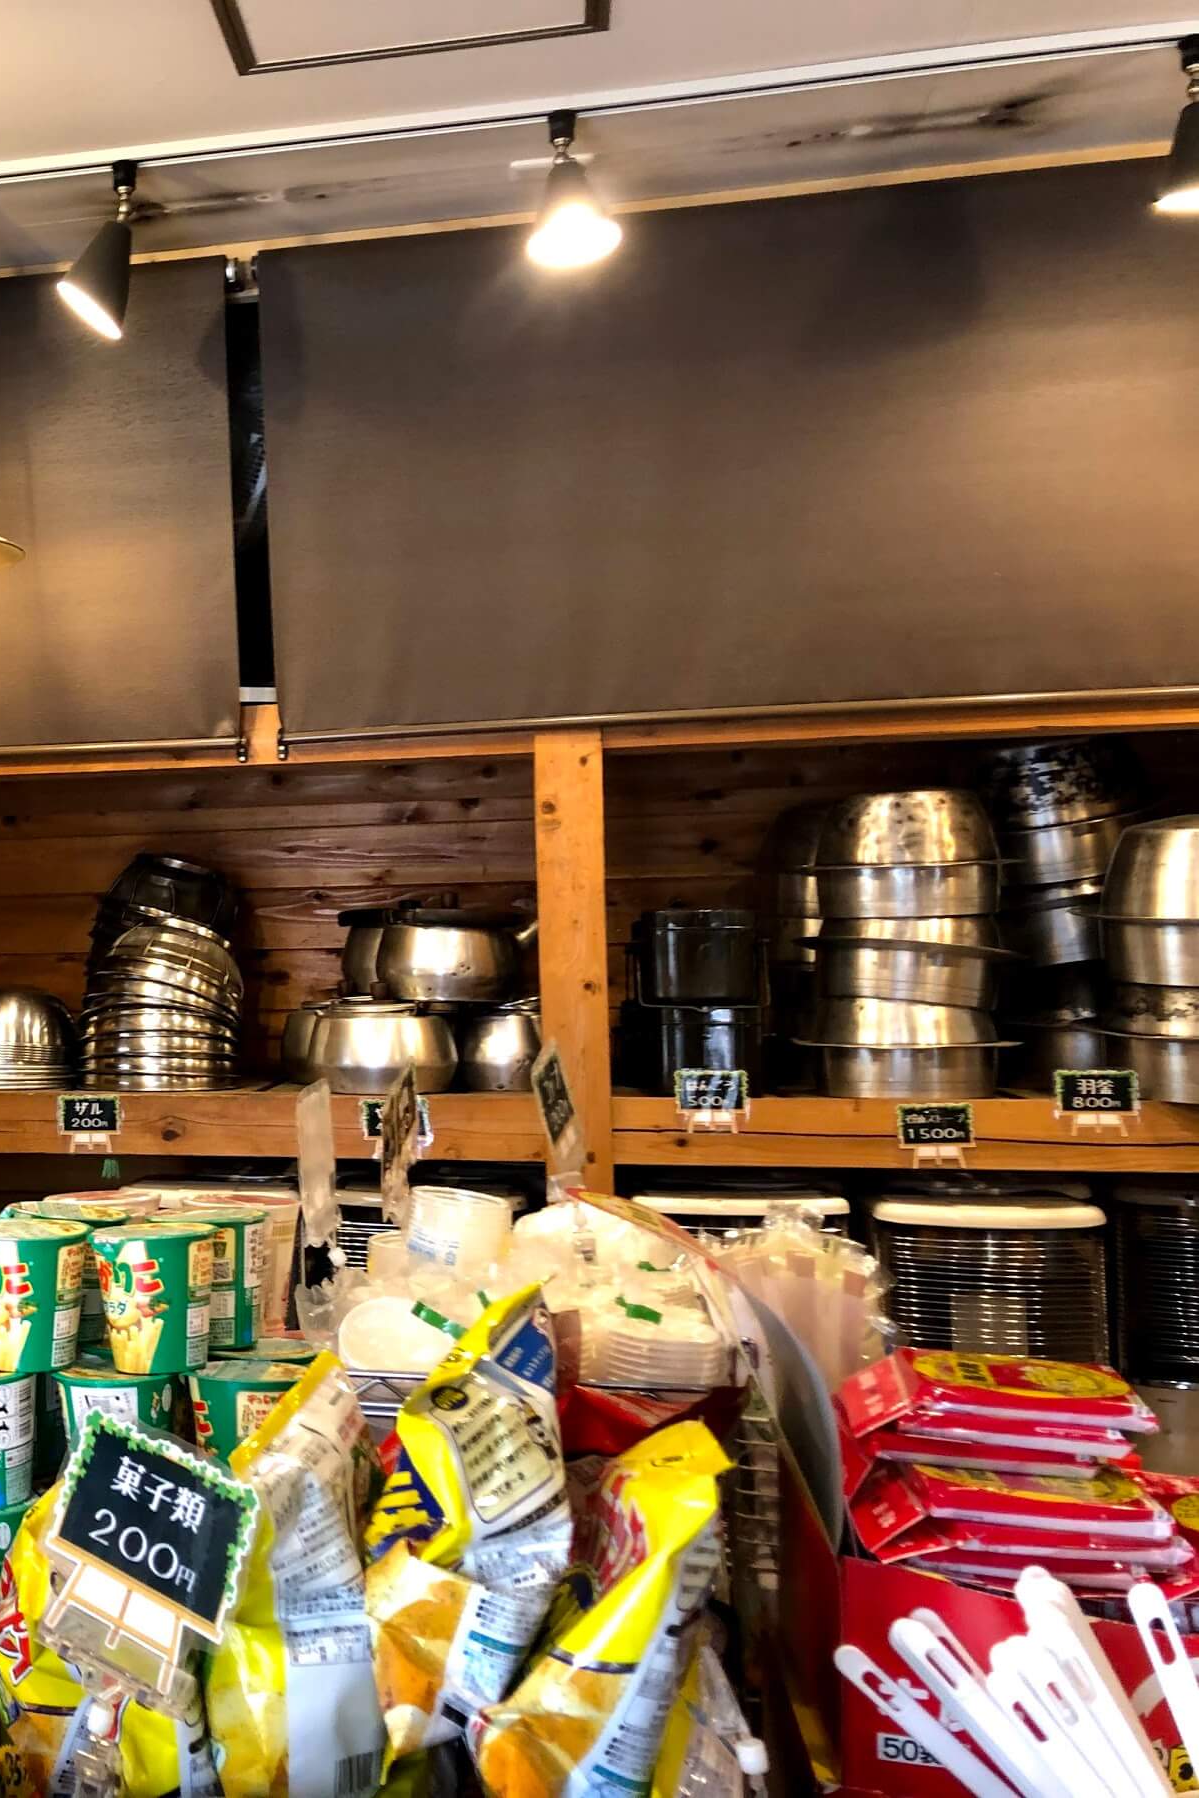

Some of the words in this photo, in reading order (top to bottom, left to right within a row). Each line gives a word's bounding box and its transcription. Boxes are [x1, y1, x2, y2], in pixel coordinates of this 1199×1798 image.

[74, 1101, 104, 1116] ザル
[1075, 1078, 1116, 1095] 羽釜
[109, 1455, 207, 1535] 菓子類
[88, 1508, 197, 1593] 200円
